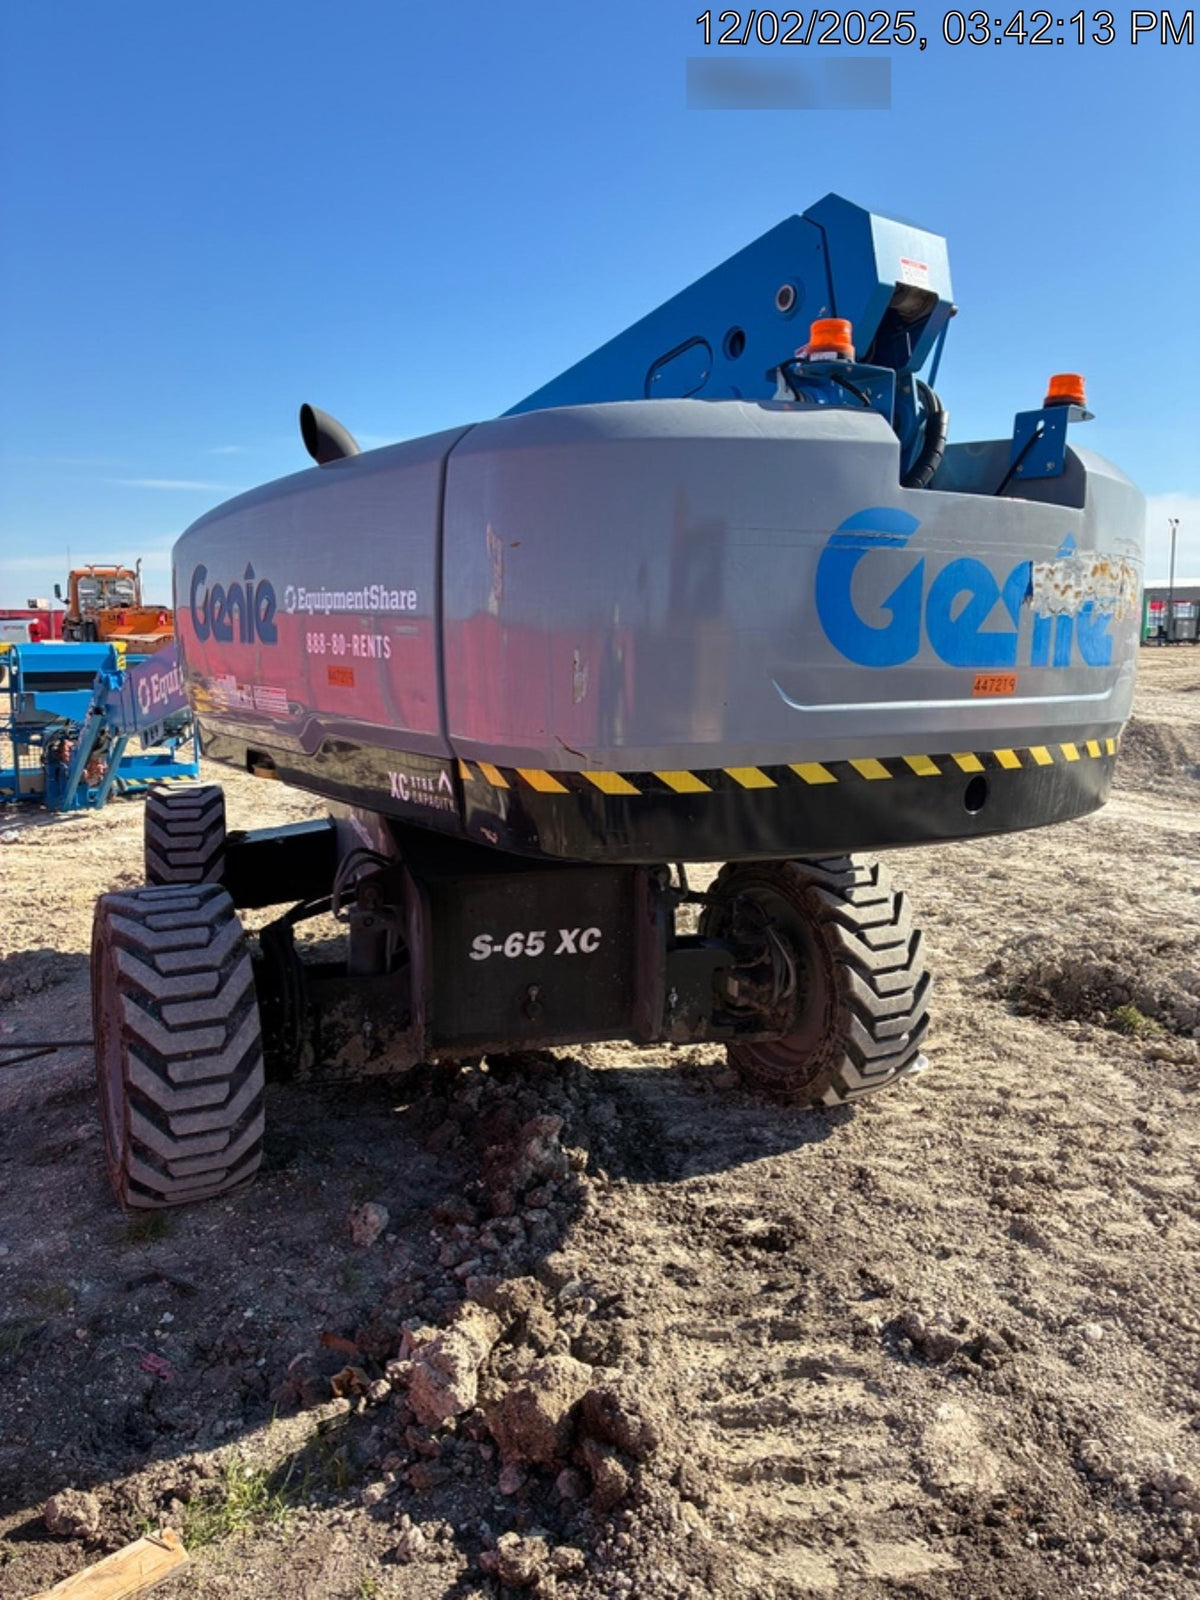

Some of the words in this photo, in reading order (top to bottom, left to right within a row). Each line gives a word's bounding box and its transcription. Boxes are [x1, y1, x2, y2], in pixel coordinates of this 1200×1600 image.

[190, 561, 278, 645] Genie
[297, 585, 417, 615] EquipmentShare
[306, 631, 392, 660] 888-80-RENTS
[973, 677, 1016, 693] 447219
[387, 770, 409, 801] XC
[469, 930, 546, 961] S-65
[553, 927, 602, 955] XC
